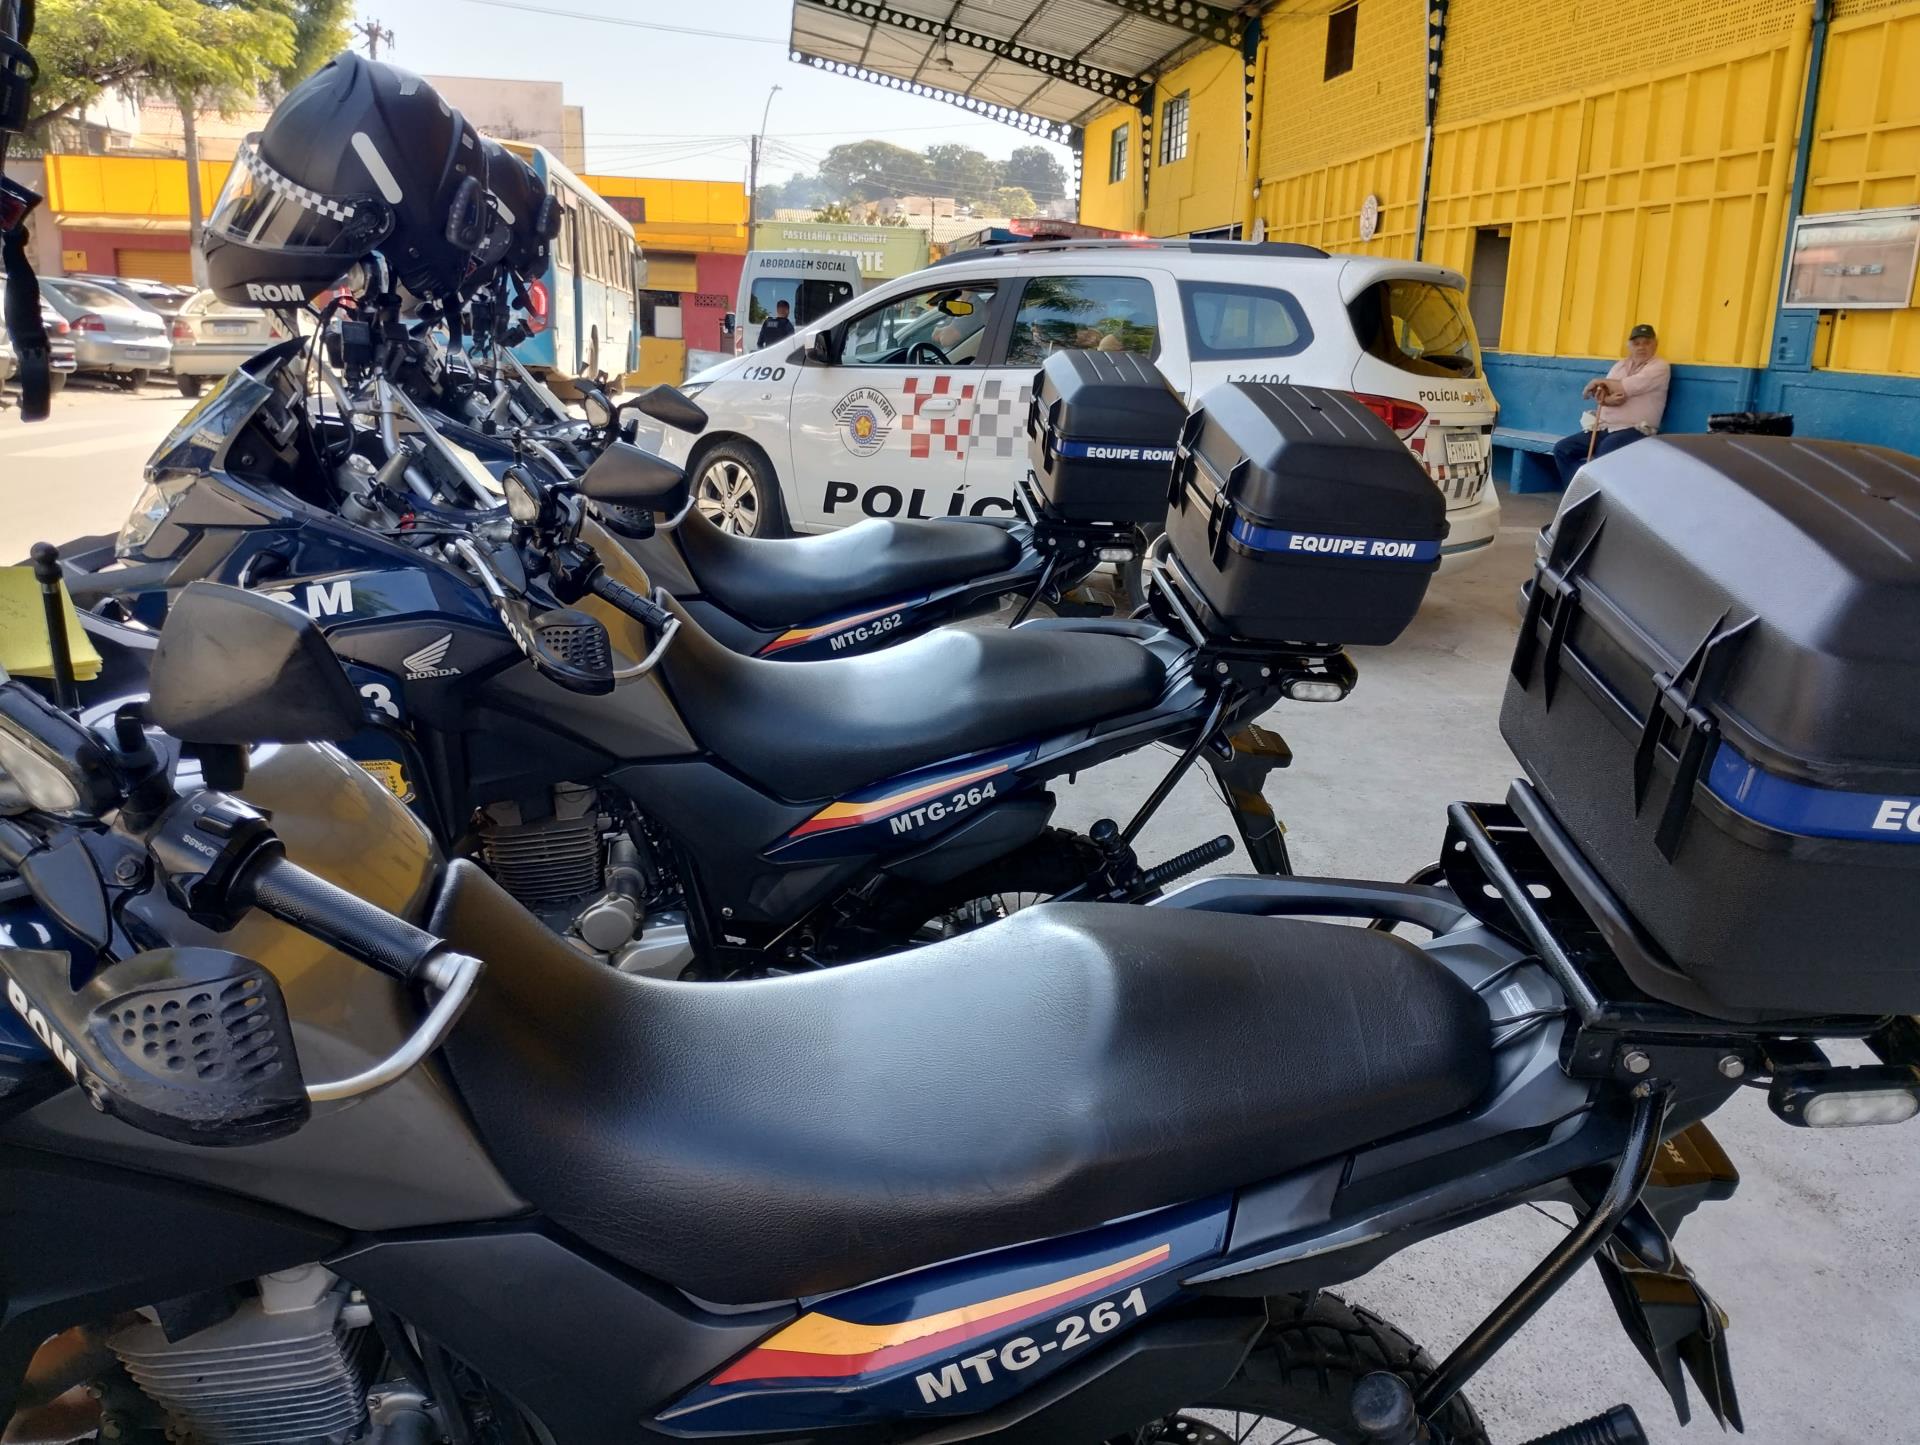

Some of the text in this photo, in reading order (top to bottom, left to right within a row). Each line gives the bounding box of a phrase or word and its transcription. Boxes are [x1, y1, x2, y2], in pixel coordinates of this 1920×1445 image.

[760, 258, 847, 272] ABORDAGEM SOCIAL
[246, 283, 305, 301] ROM
[835, 391, 893, 418] POLÍCIA MILITAR
[1419, 388, 1460, 401] POLÍCIA
[1087, 447, 1174, 461] EQUIPE ROM
[1289, 535, 1416, 557] EQUIPE ROM
[830, 613, 903, 651] MTG-262
[406, 667, 462, 681] HONDA
[889, 782, 997, 835] MTG-264
[183, 834, 206, 852] PASS
[8, 978, 78, 1081] ROM
[916, 1287, 1148, 1404] MTG-261
